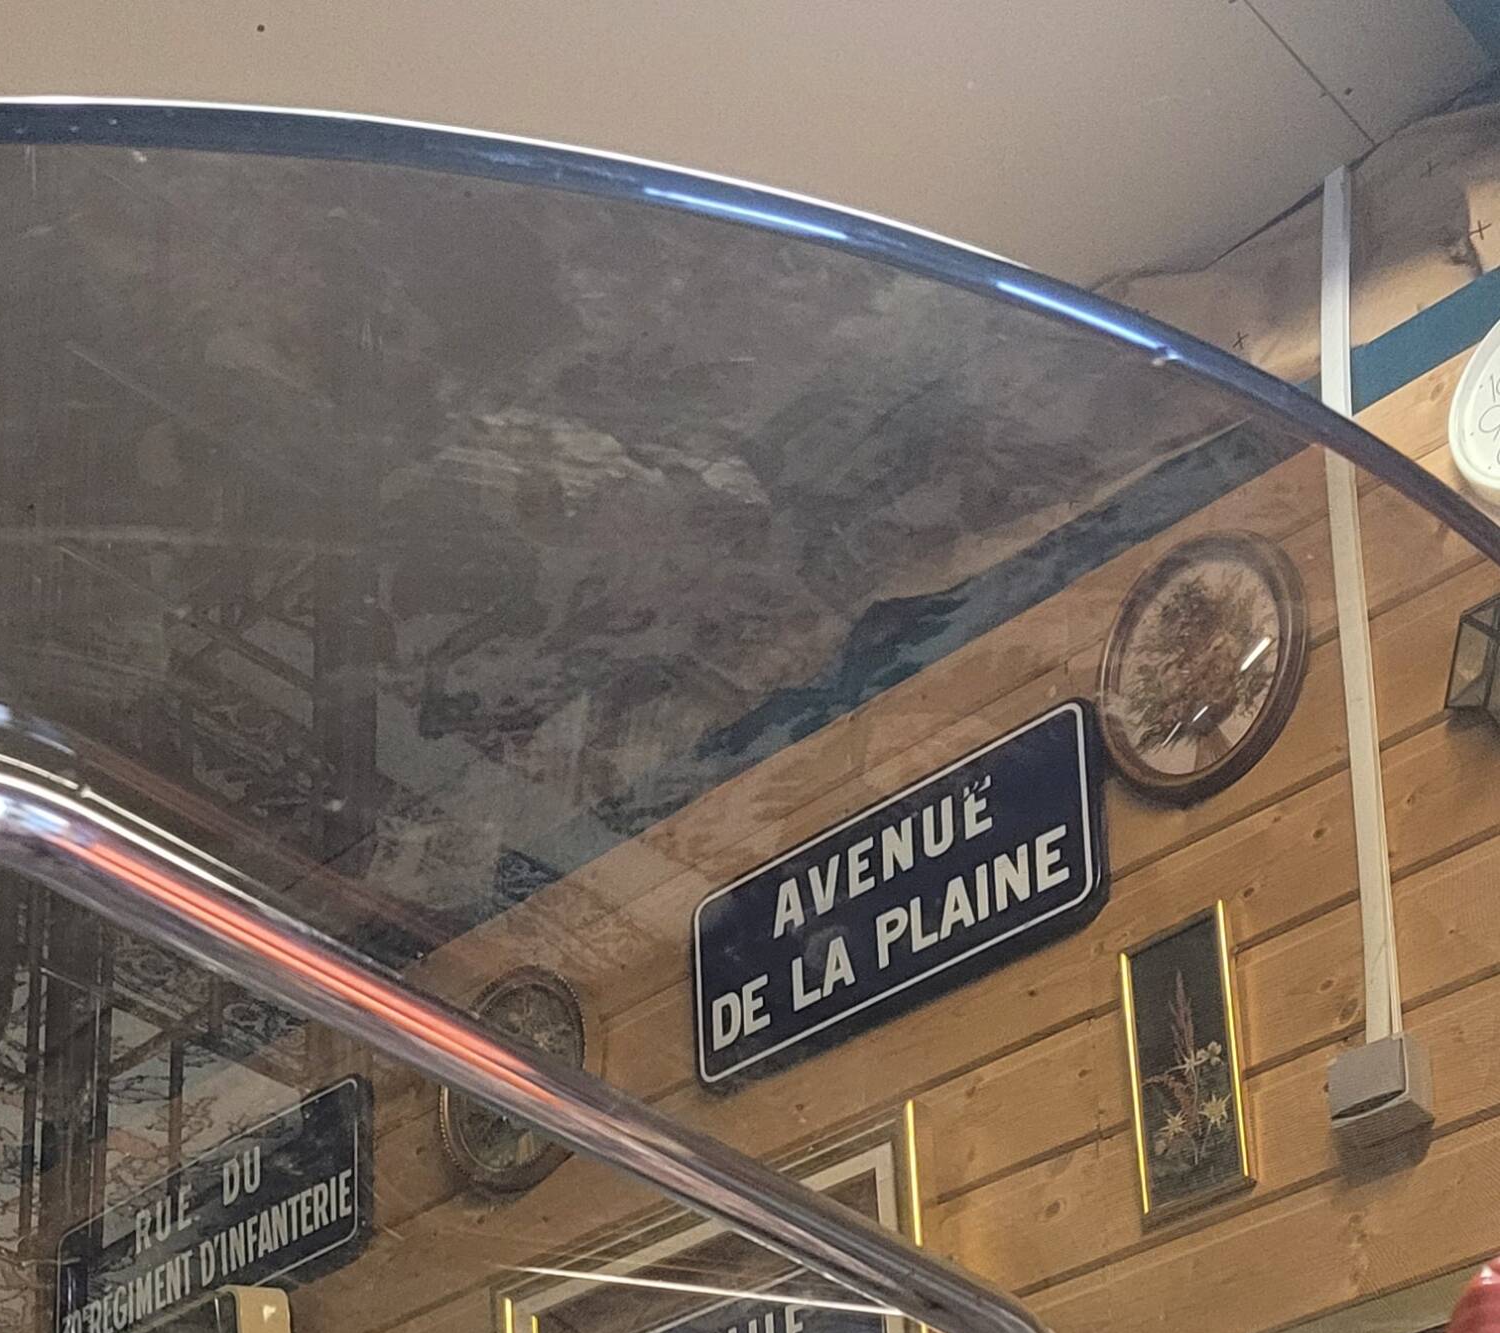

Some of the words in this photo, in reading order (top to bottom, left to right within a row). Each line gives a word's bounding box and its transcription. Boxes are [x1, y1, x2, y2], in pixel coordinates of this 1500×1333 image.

[712, 974, 771, 1052] DE
[791, 936, 856, 1013] LA
[876, 825, 1070, 970] PLAINE
[134, 1184, 193, 1255] RUE
[222, 1146, 261, 1206] DU
[199, 1168, 352, 1288] D'INFANTERIE
